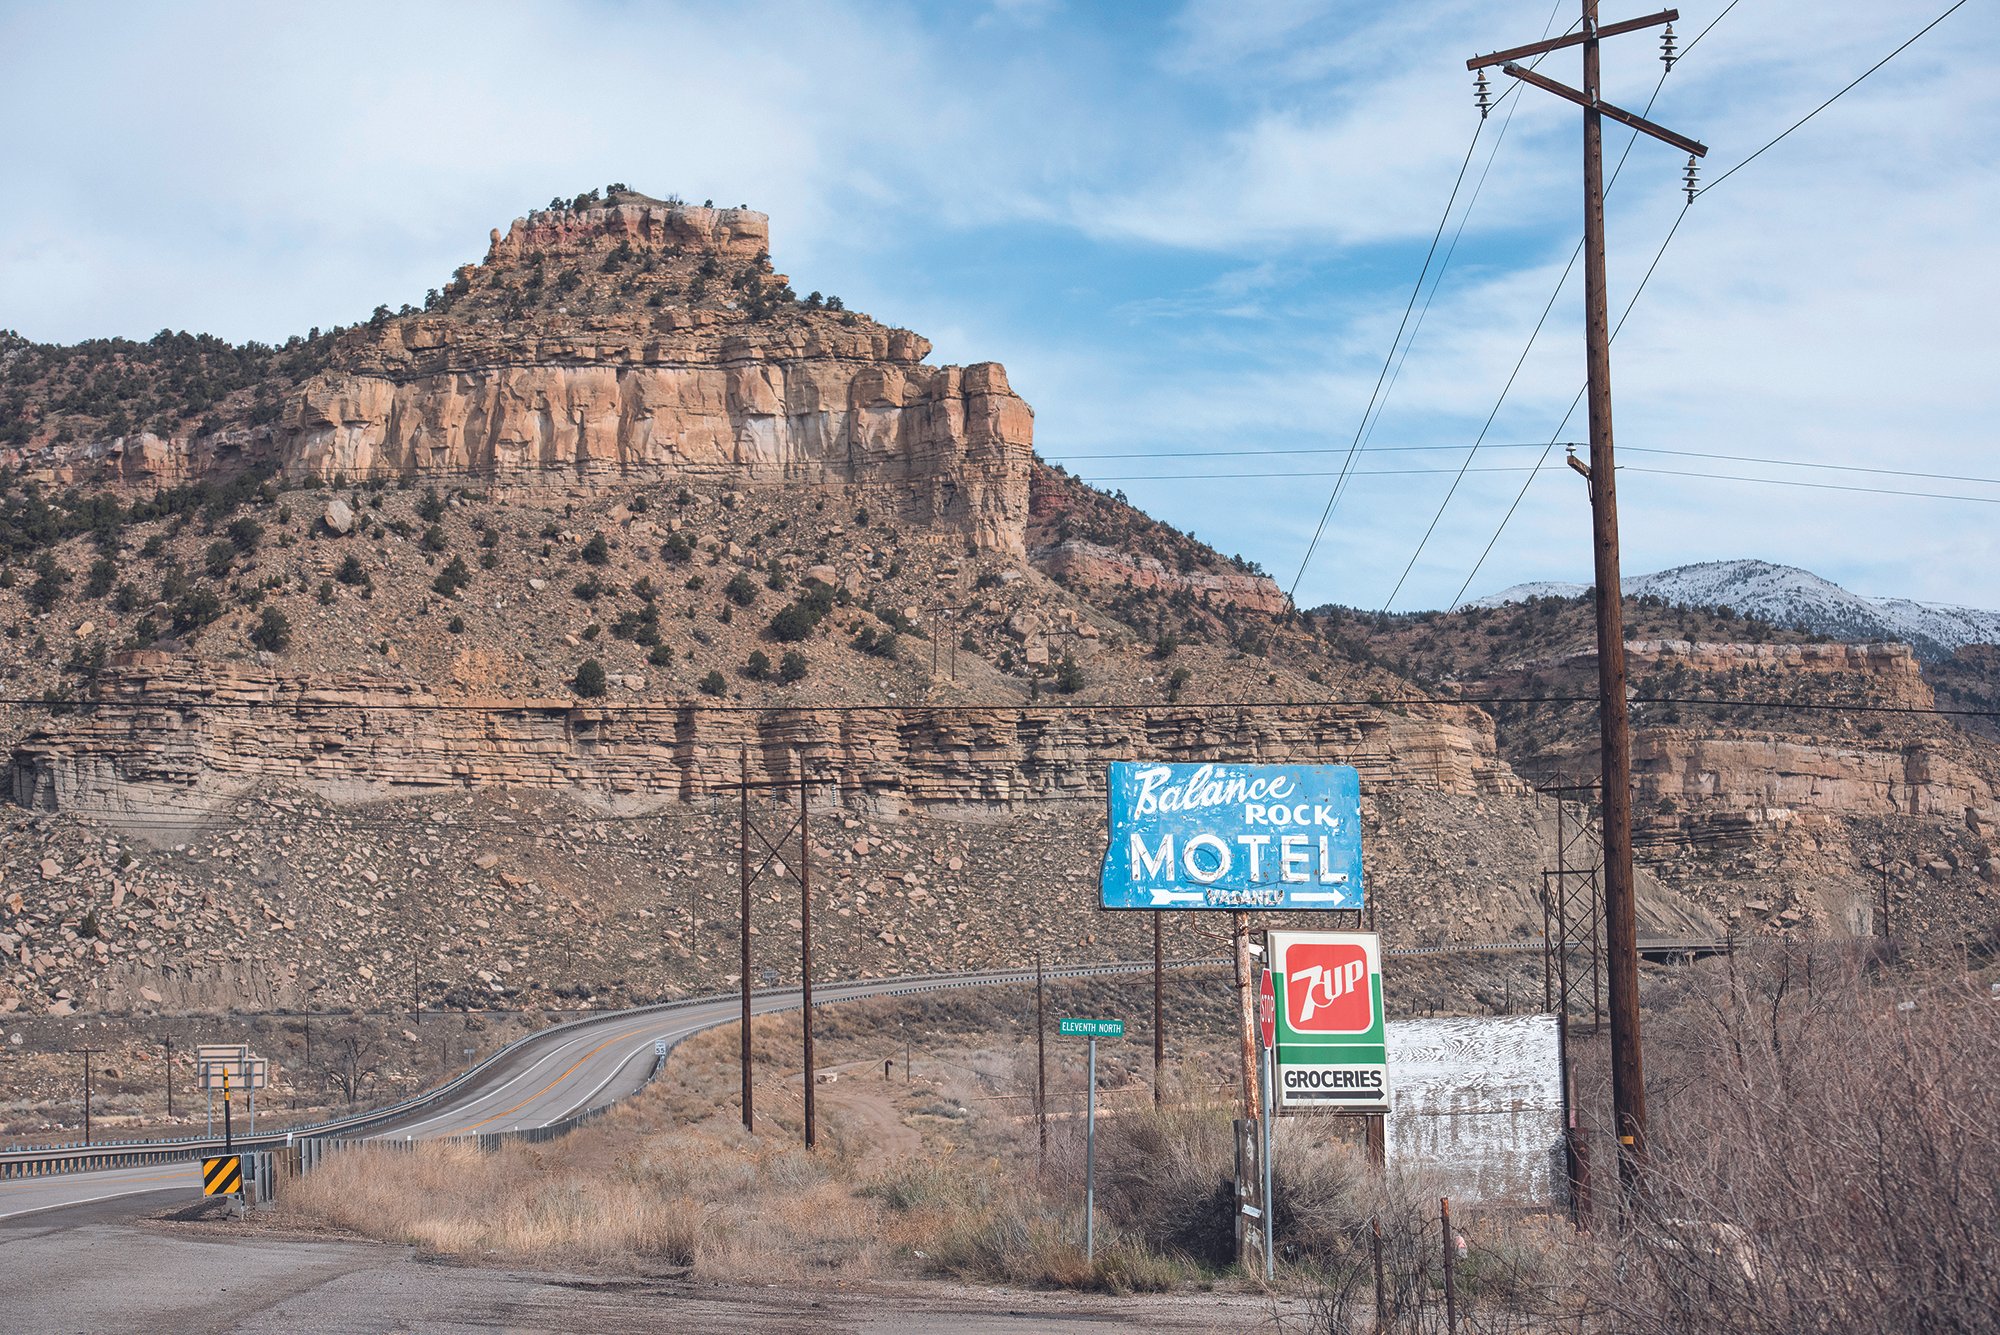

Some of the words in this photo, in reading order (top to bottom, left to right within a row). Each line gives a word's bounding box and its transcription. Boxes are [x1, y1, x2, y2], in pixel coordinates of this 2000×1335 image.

[1134, 764, 1295, 820] Balance
[1245, 804, 1341, 826] ROCK
[1130, 833, 1349, 884] MOTEL
[1260, 994, 1275, 1024] STOP
[1062, 1021, 1096, 1032] ELEVENTH
[1099, 1023, 1121, 1033] NORTH
[1284, 1070, 1383, 1089] GROCERIES
